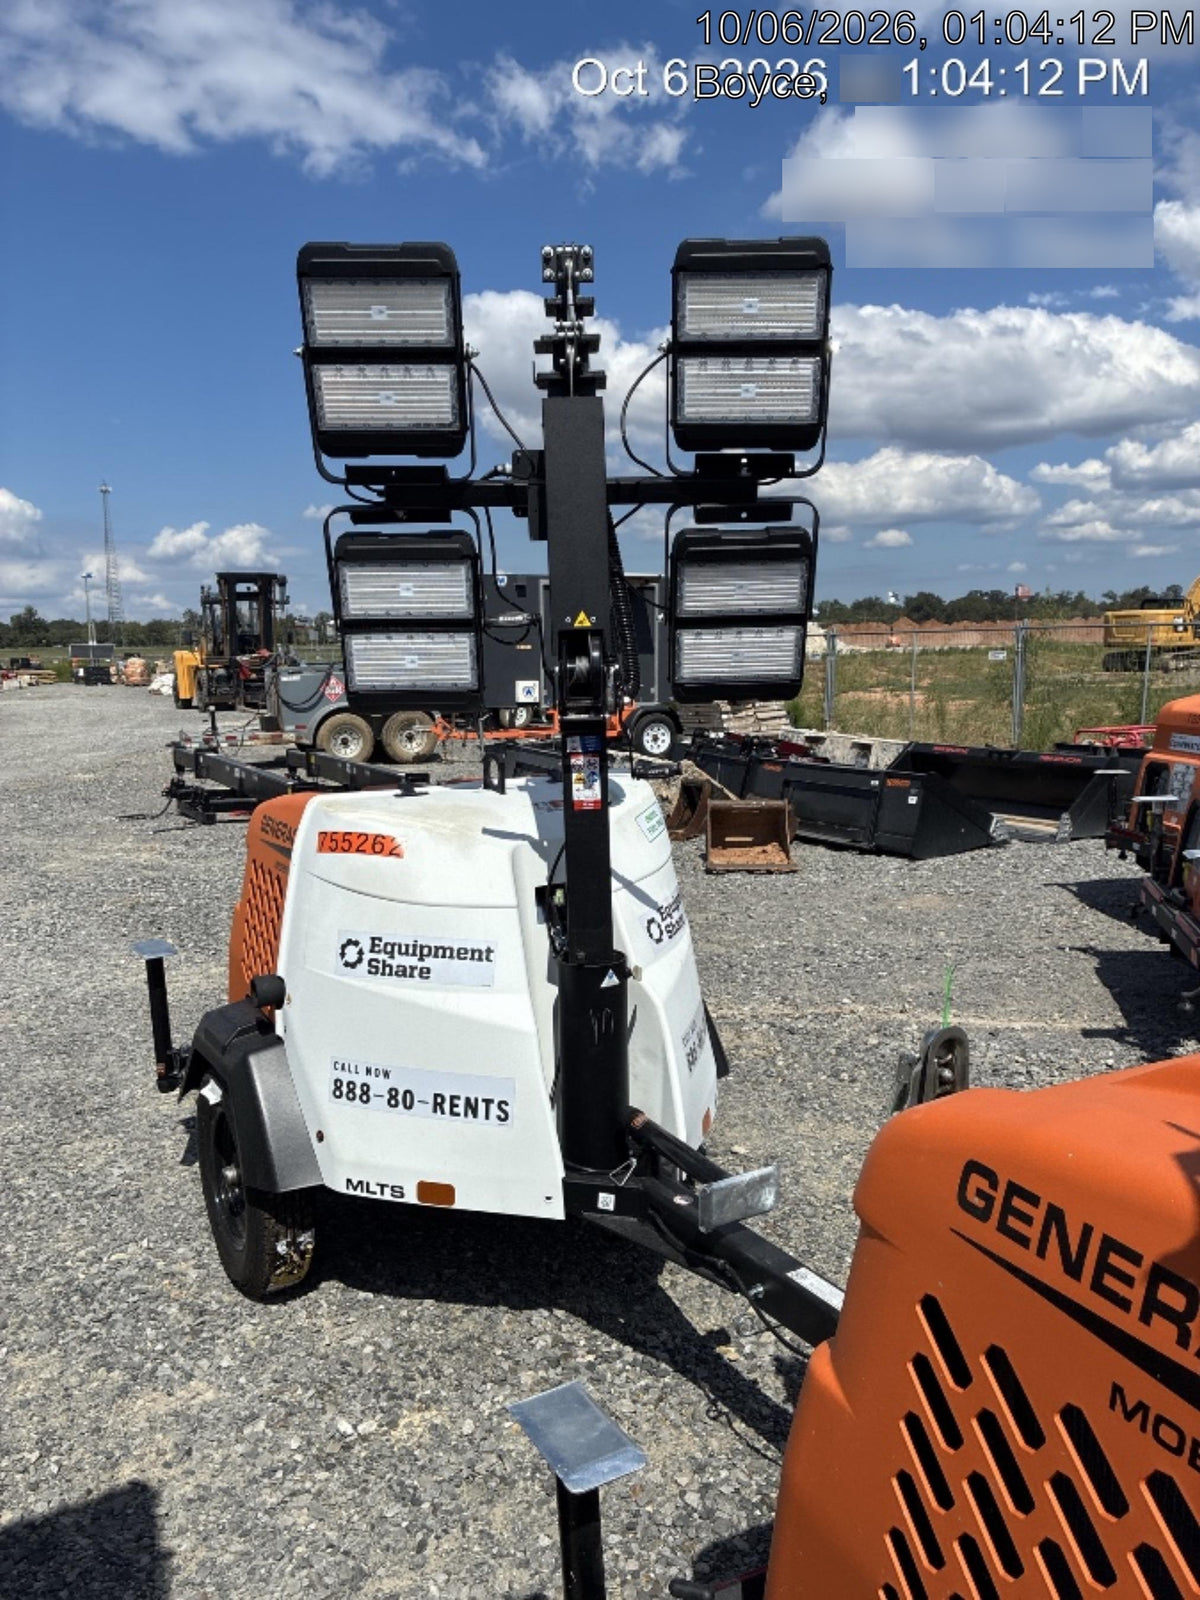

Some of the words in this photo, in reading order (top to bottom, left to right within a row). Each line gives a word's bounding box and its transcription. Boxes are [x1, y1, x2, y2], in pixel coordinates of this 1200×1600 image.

[369, 936, 495, 962] Equipment
[367, 958, 431, 980] Share
[333, 1061, 360, 1075] CALL
[365, 1066, 392, 1080] NOW
[332, 1078, 510, 1122] 888-80-RENTS
[346, 1178, 405, 1198] MLTS
[957, 1159, 1200, 1358] GENER
